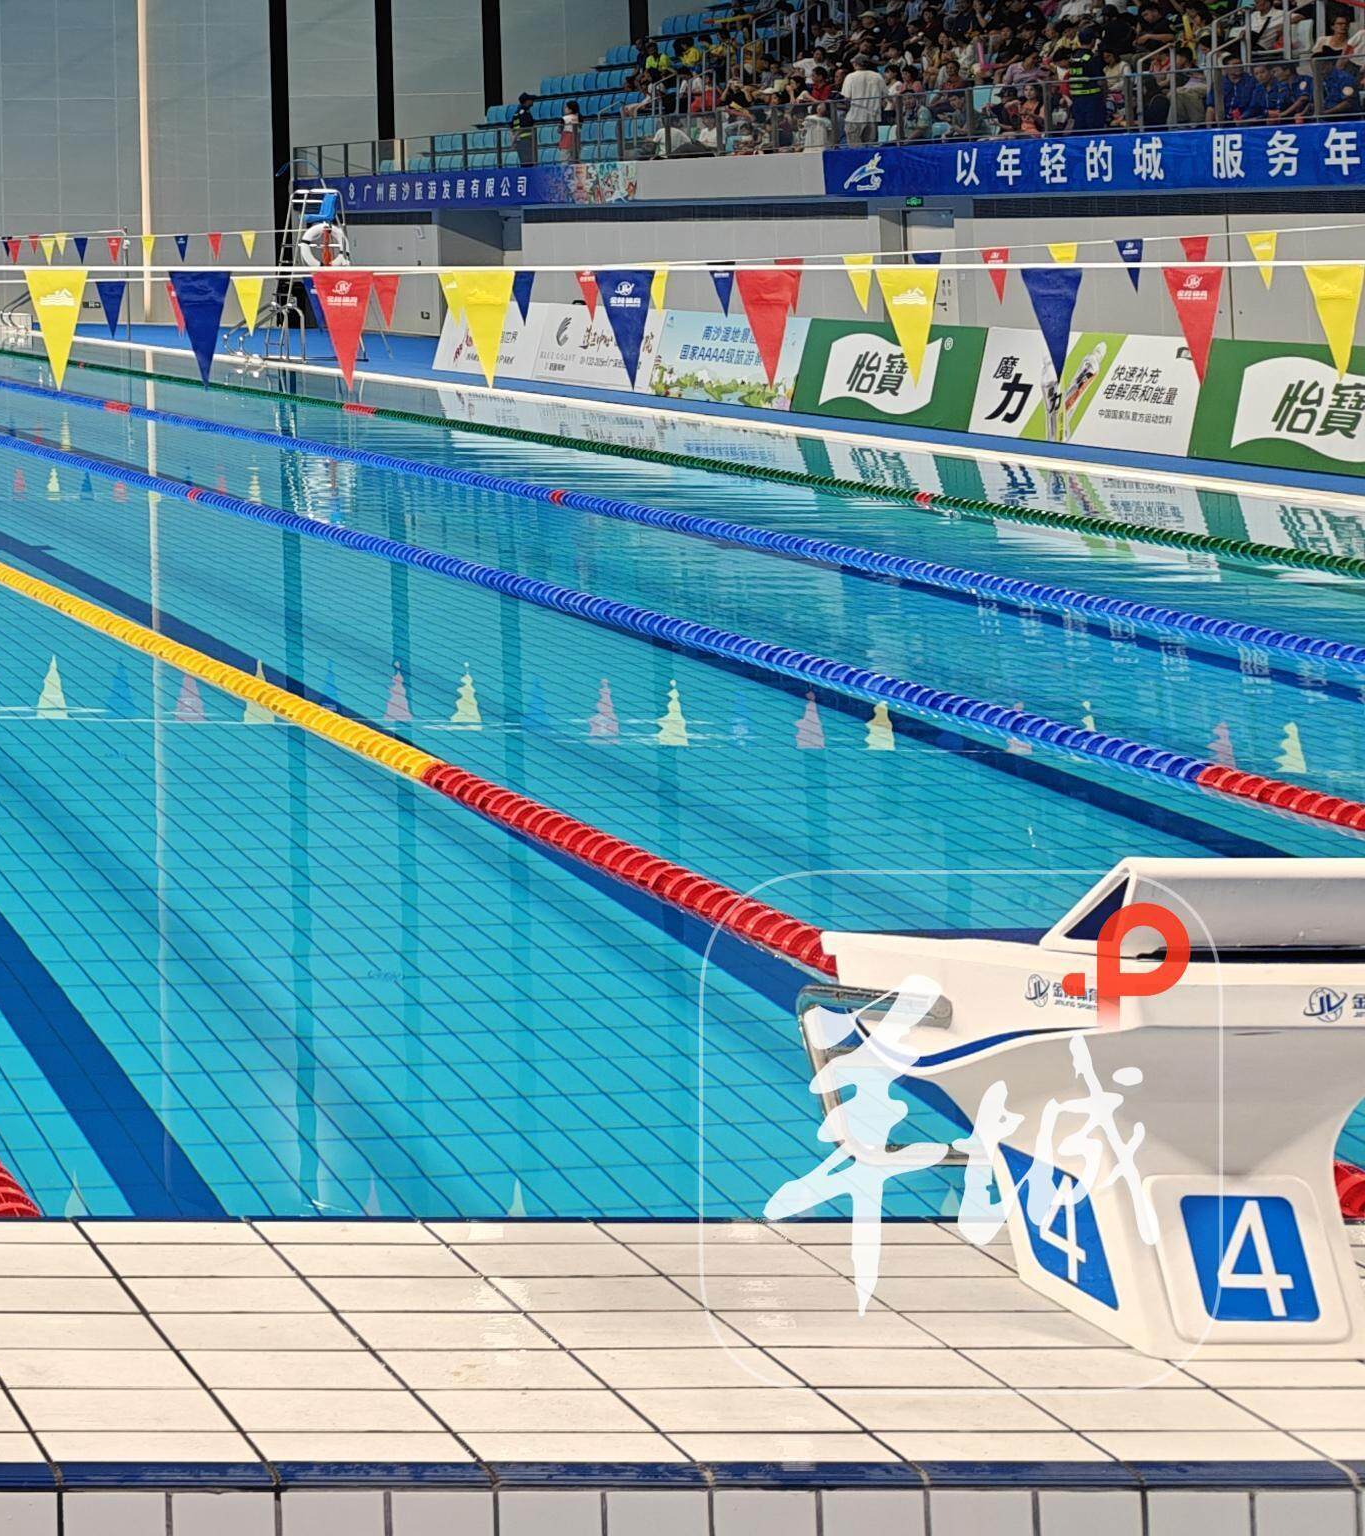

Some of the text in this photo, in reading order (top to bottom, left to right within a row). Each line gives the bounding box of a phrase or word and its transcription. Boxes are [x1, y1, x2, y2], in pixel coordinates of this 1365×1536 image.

[955, 127, 1362, 187] 以年轻的城 服务年
[363, 176, 527, 203] 广州南沙旅游发展有限公司
[984, 355, 1034, 424] 魔力
[1103, 383, 1179, 406] 电解质和能量
[1111, 365, 1162, 384] 快速补充
[1097, 408, 1173, 425] 中国国家队官方运动饮料
[1038, 1173, 1087, 1284] 4
[1217, 1200, 1295, 1318] 4
